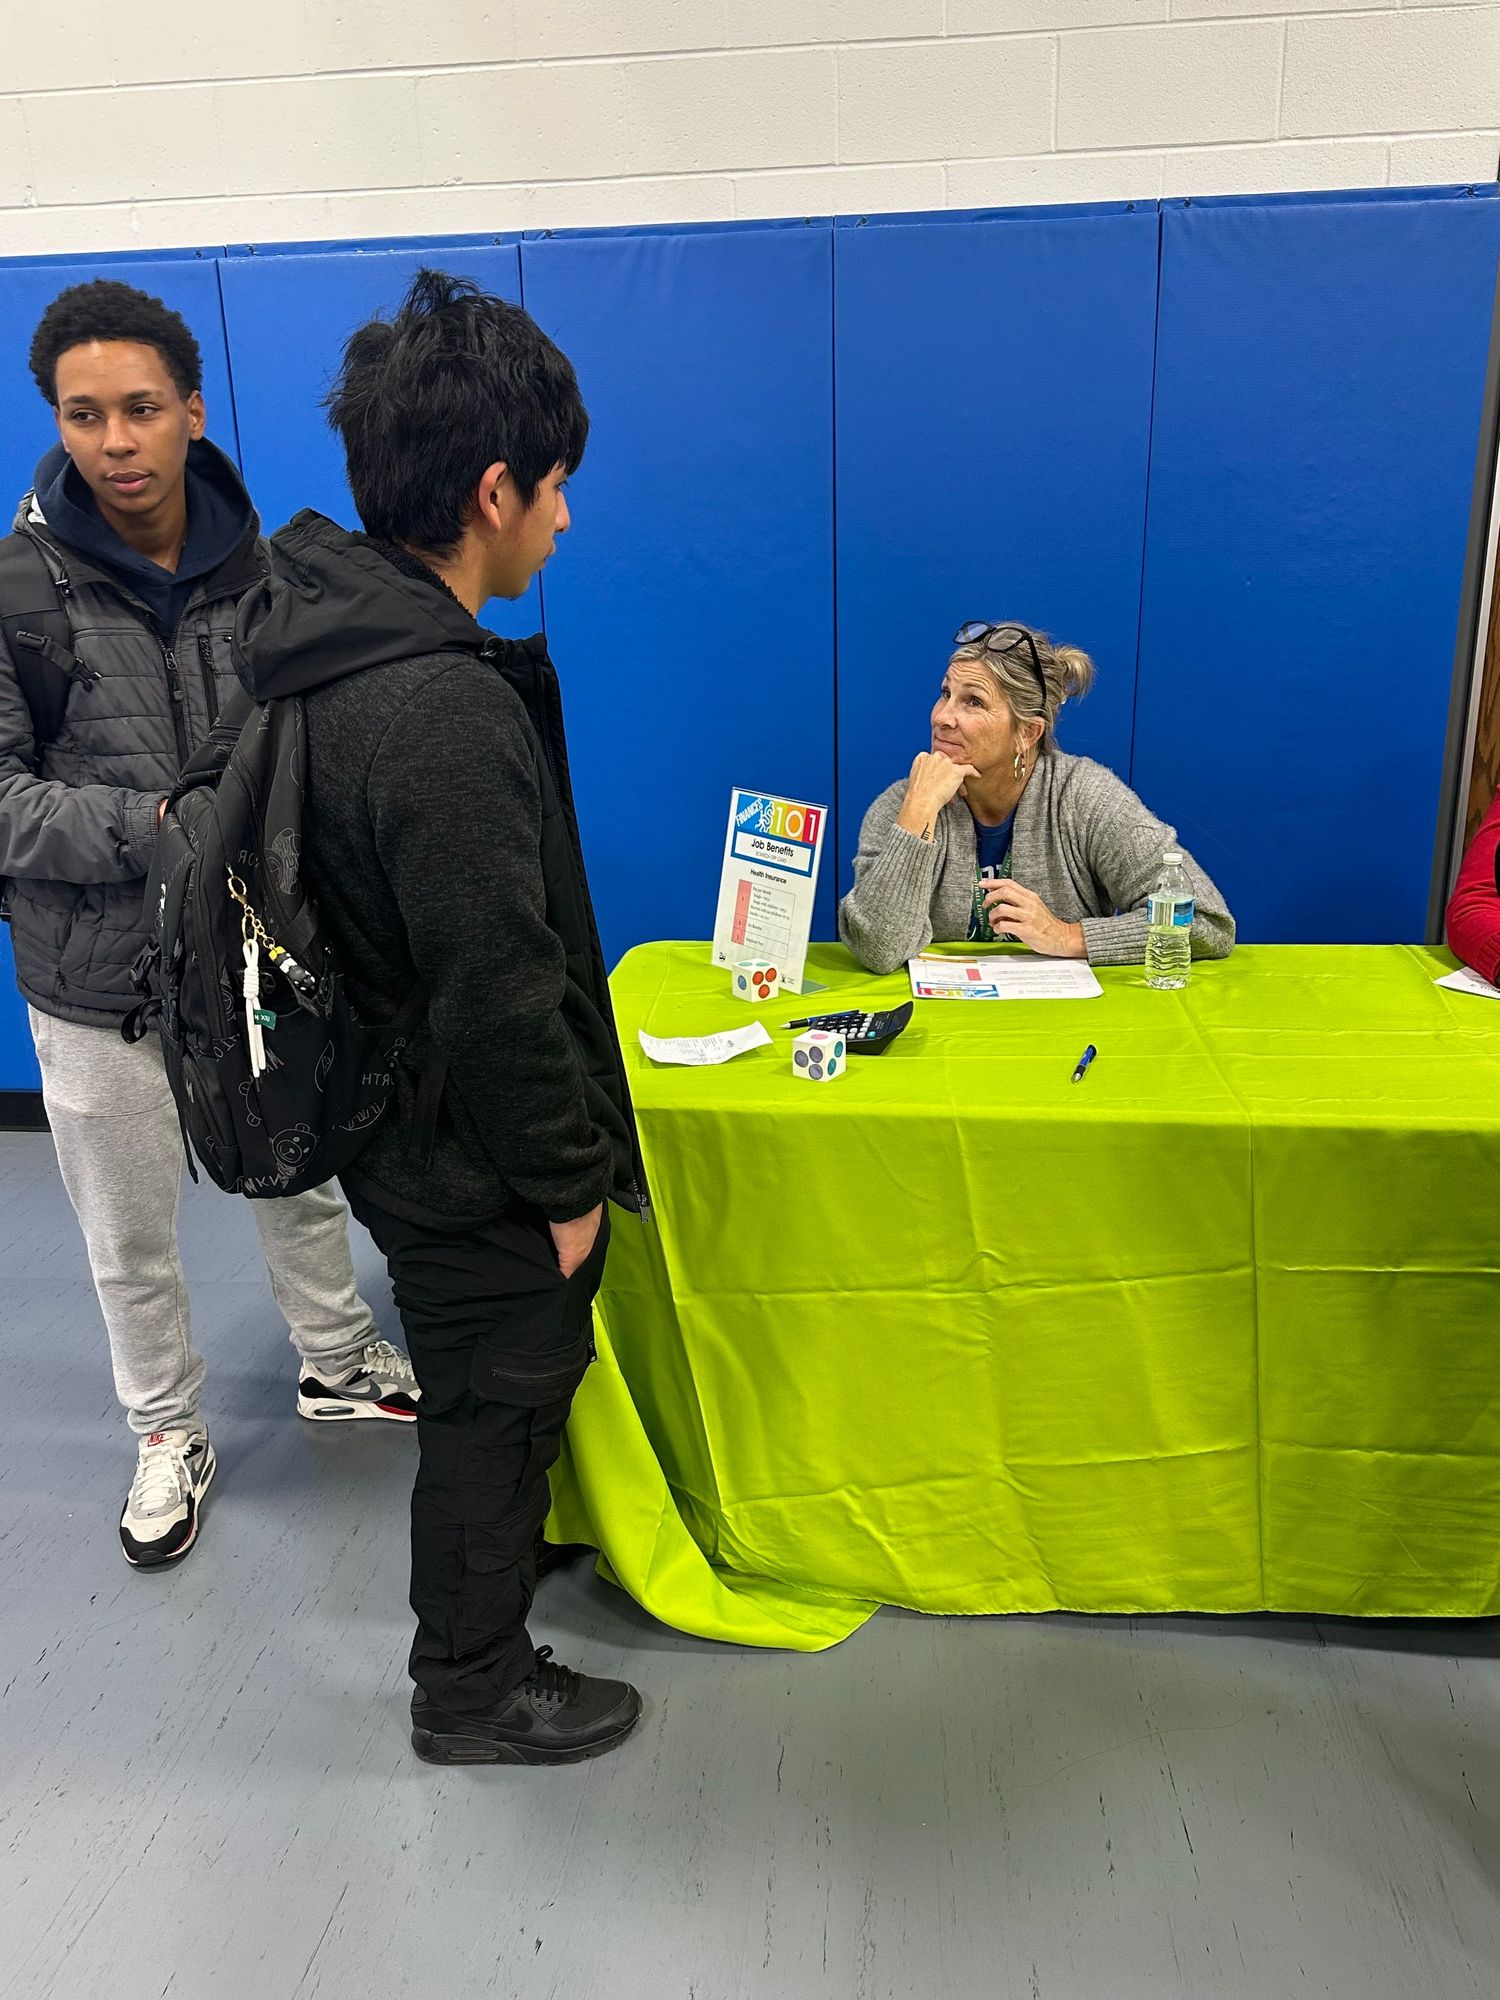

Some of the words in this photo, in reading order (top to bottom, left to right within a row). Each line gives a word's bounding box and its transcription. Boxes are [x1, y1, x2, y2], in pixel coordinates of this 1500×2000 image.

[775, 806, 817, 841] 101
[751, 838, 765, 849] Job
[767, 841, 794, 857] Benefits
[750, 868, 764, 878] Health
[765, 872, 787, 884] Insurance
